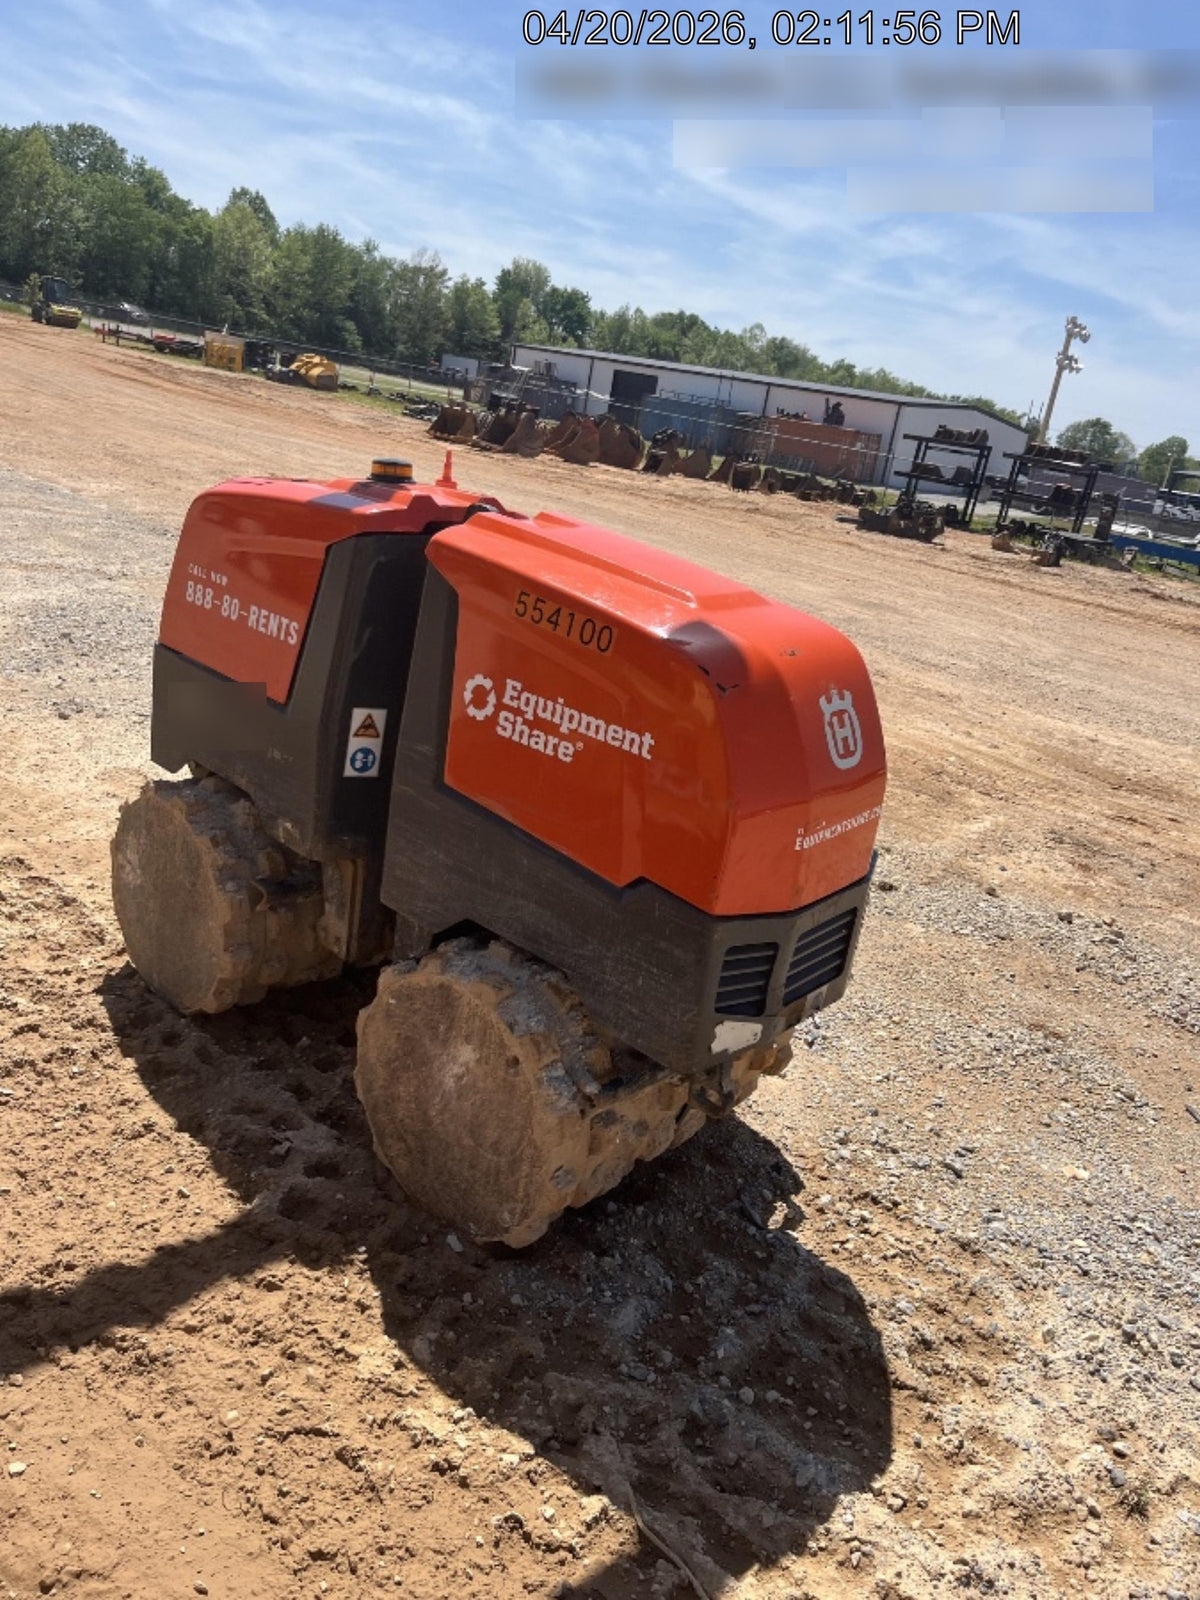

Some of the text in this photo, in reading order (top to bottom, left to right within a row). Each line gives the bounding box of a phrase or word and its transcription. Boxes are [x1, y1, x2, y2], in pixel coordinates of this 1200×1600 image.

[185, 581, 299, 645] 888-80-RENTS
[514, 591, 613, 653] 554100
[502, 678, 655, 760] Equipment
